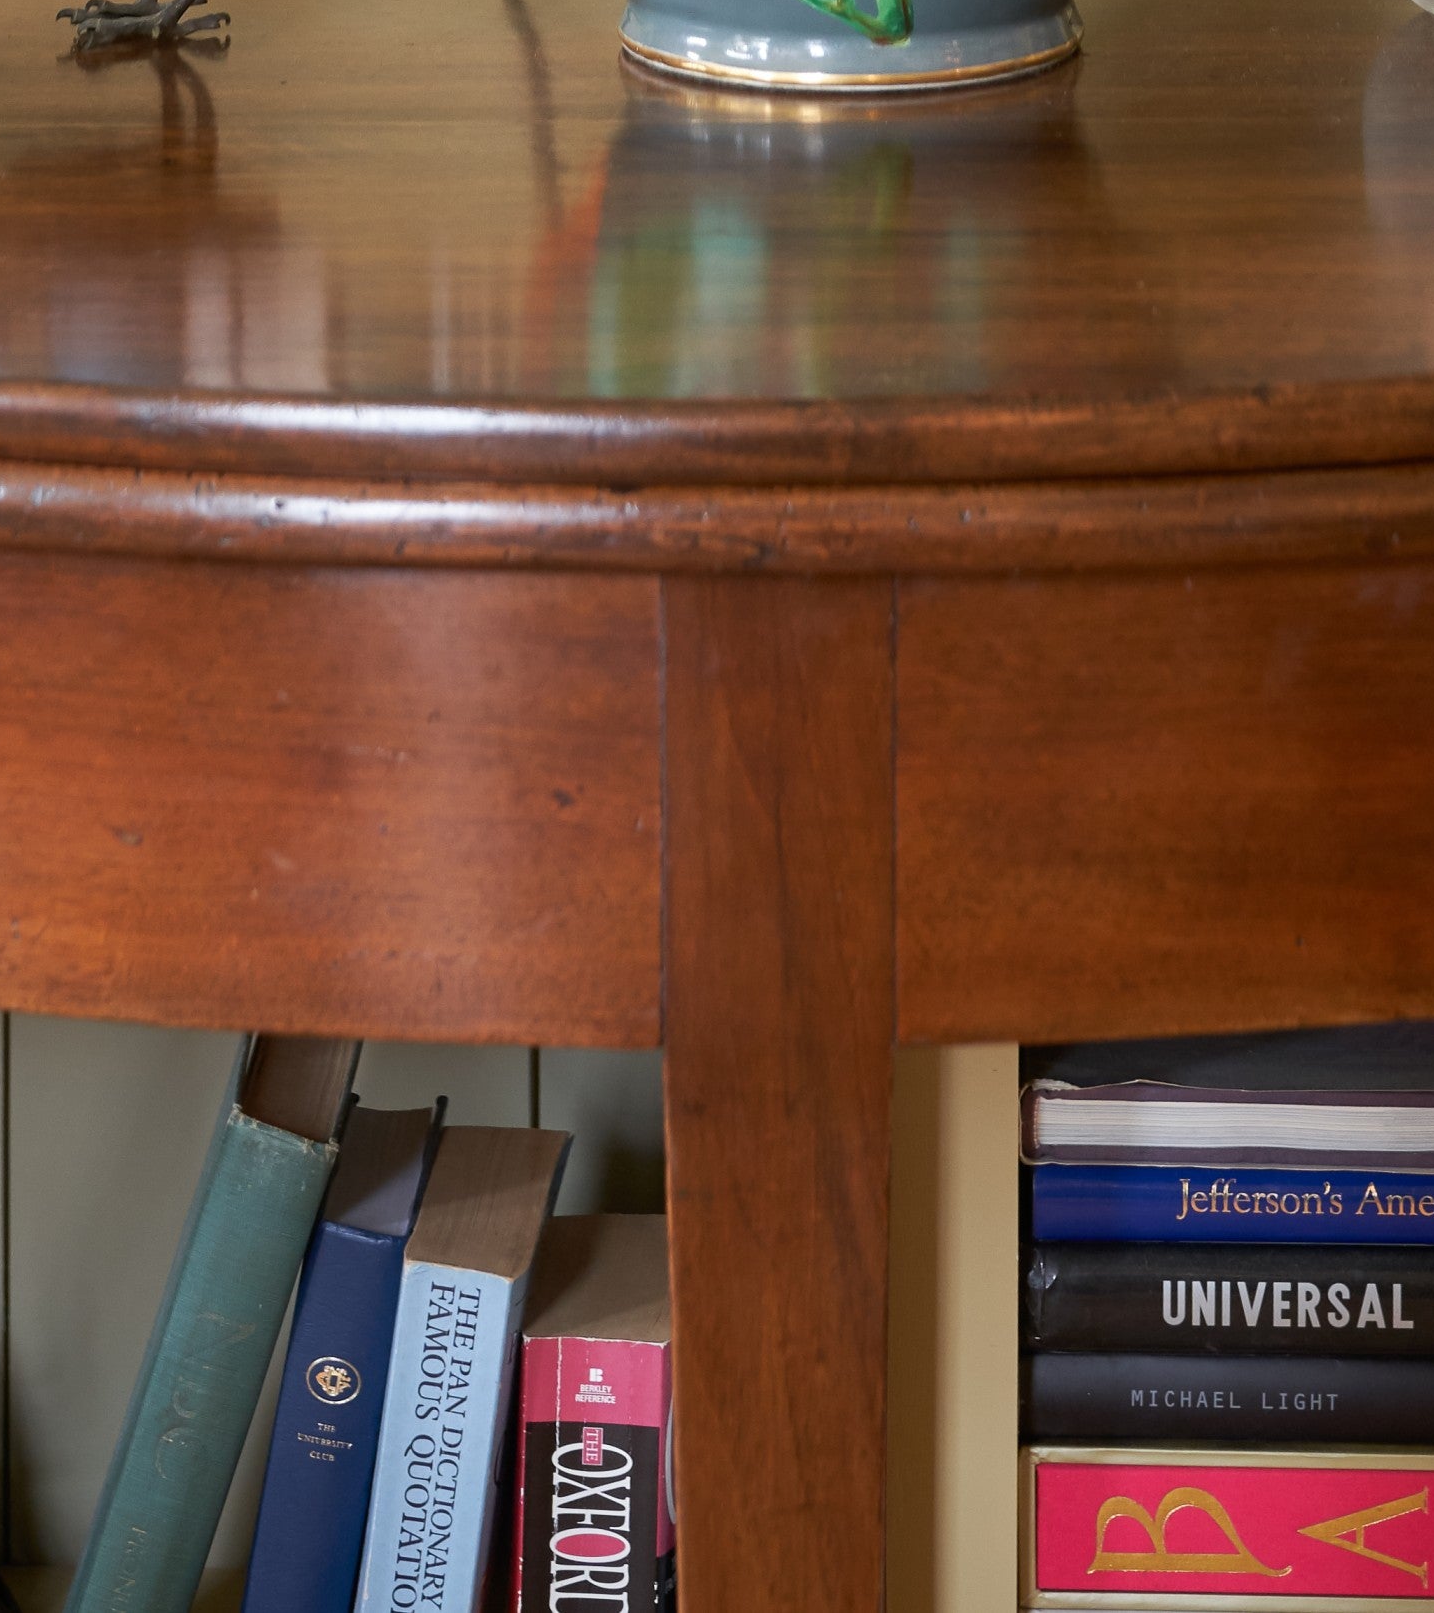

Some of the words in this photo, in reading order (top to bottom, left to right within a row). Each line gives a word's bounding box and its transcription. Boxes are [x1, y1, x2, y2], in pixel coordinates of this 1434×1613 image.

[1176, 1179, 1344, 1223] Jefferson's
[1161, 1280, 1414, 1331] UNIVERSAL
[1130, 1389, 1248, 1410] MICHAEL
[1260, 1392, 1338, 1410] LIGHT
